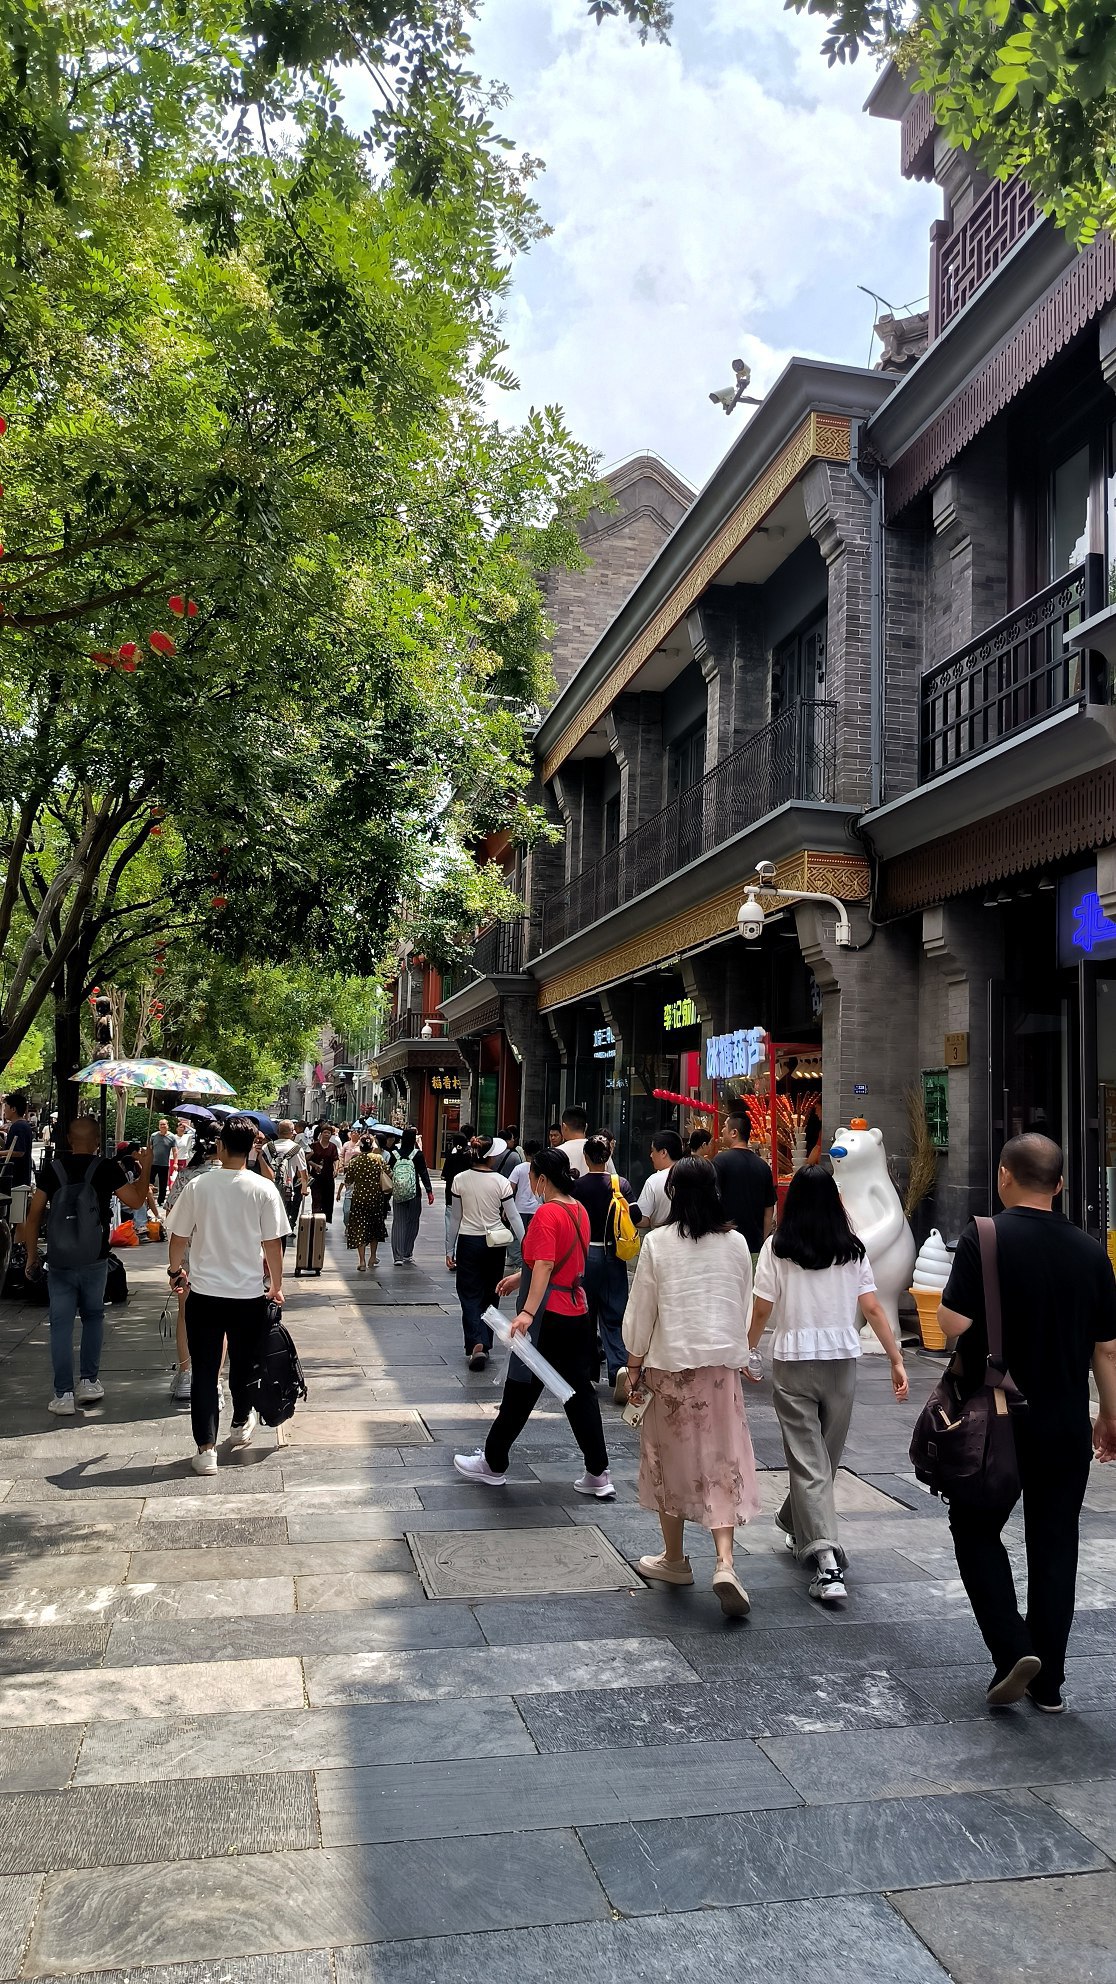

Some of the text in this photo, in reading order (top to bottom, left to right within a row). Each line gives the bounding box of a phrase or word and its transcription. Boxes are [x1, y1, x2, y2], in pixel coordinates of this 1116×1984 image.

[706, 1026, 766, 1079] 冰糖葫芦
[953, 1046, 958, 1060] 3
[431, 1075, 461, 1090] 稻香村
